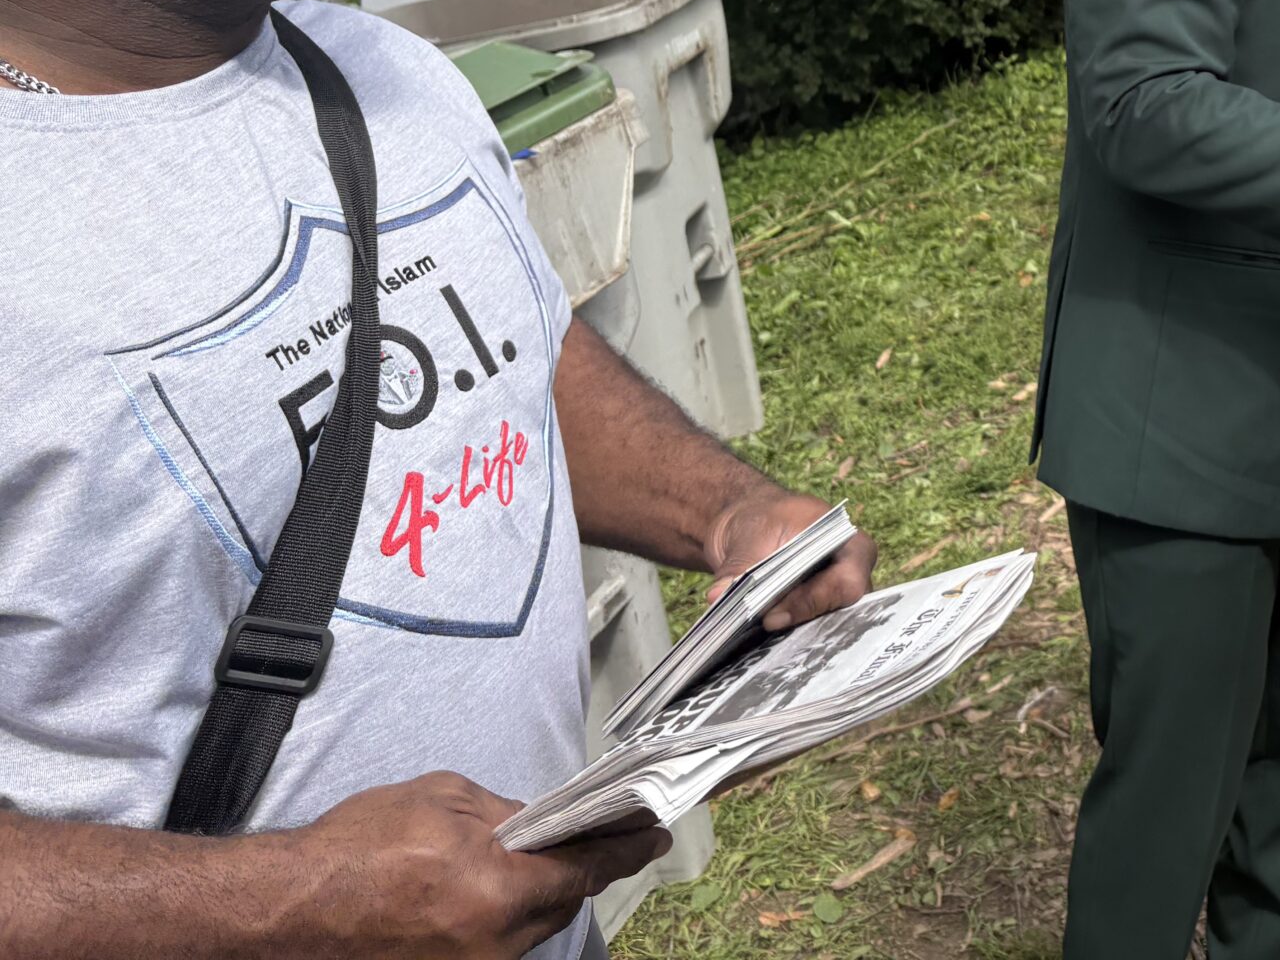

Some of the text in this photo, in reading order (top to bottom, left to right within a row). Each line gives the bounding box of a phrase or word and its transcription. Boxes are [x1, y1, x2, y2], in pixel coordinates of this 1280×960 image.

[265, 337, 311, 372] The
[377, 255, 437, 296] Islam
[902, 607, 944, 637] The
